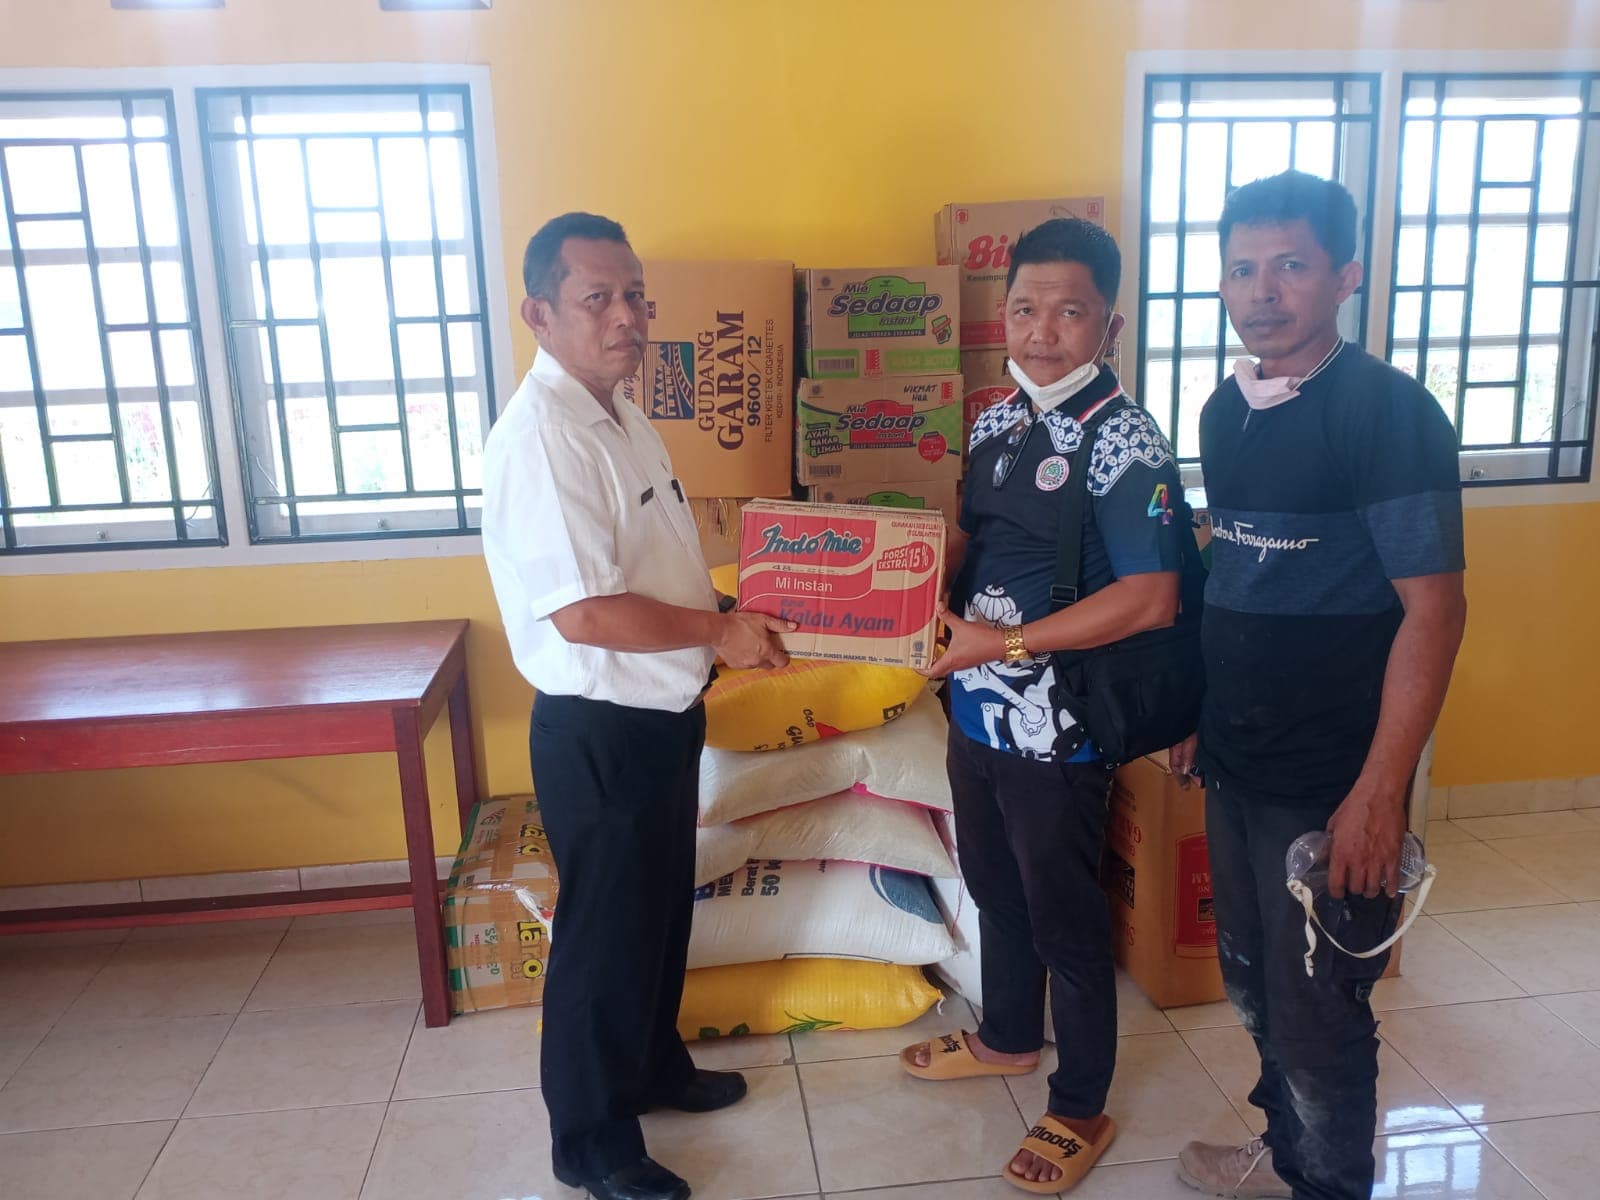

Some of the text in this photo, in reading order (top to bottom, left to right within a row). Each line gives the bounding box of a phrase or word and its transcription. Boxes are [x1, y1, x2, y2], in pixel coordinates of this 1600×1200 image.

[843, 282, 868, 295] Mie
[829, 291, 941, 317] Sedaap
[776, 344, 784, 387] INDONESIA
[698, 329, 715, 432] GUDANG
[716, 310, 744, 450] GARAM
[747, 335, 761, 427] 9600/12
[765, 319, 774, 443] FILTER KRETEK CIGARETTES
[846, 404, 866, 413] Mie
[835, 413, 926, 431] Sedaap
[806, 430, 829, 440] AYAM
[878, 559, 908, 569] EKSTRA
[884, 547, 908, 560] PORSI
[775, 577, 833, 592] Mi Instan
[779, 608, 894, 633] Kaldu Ayam
[741, 865, 758, 896] Berat
[760, 874, 781, 896] 50
